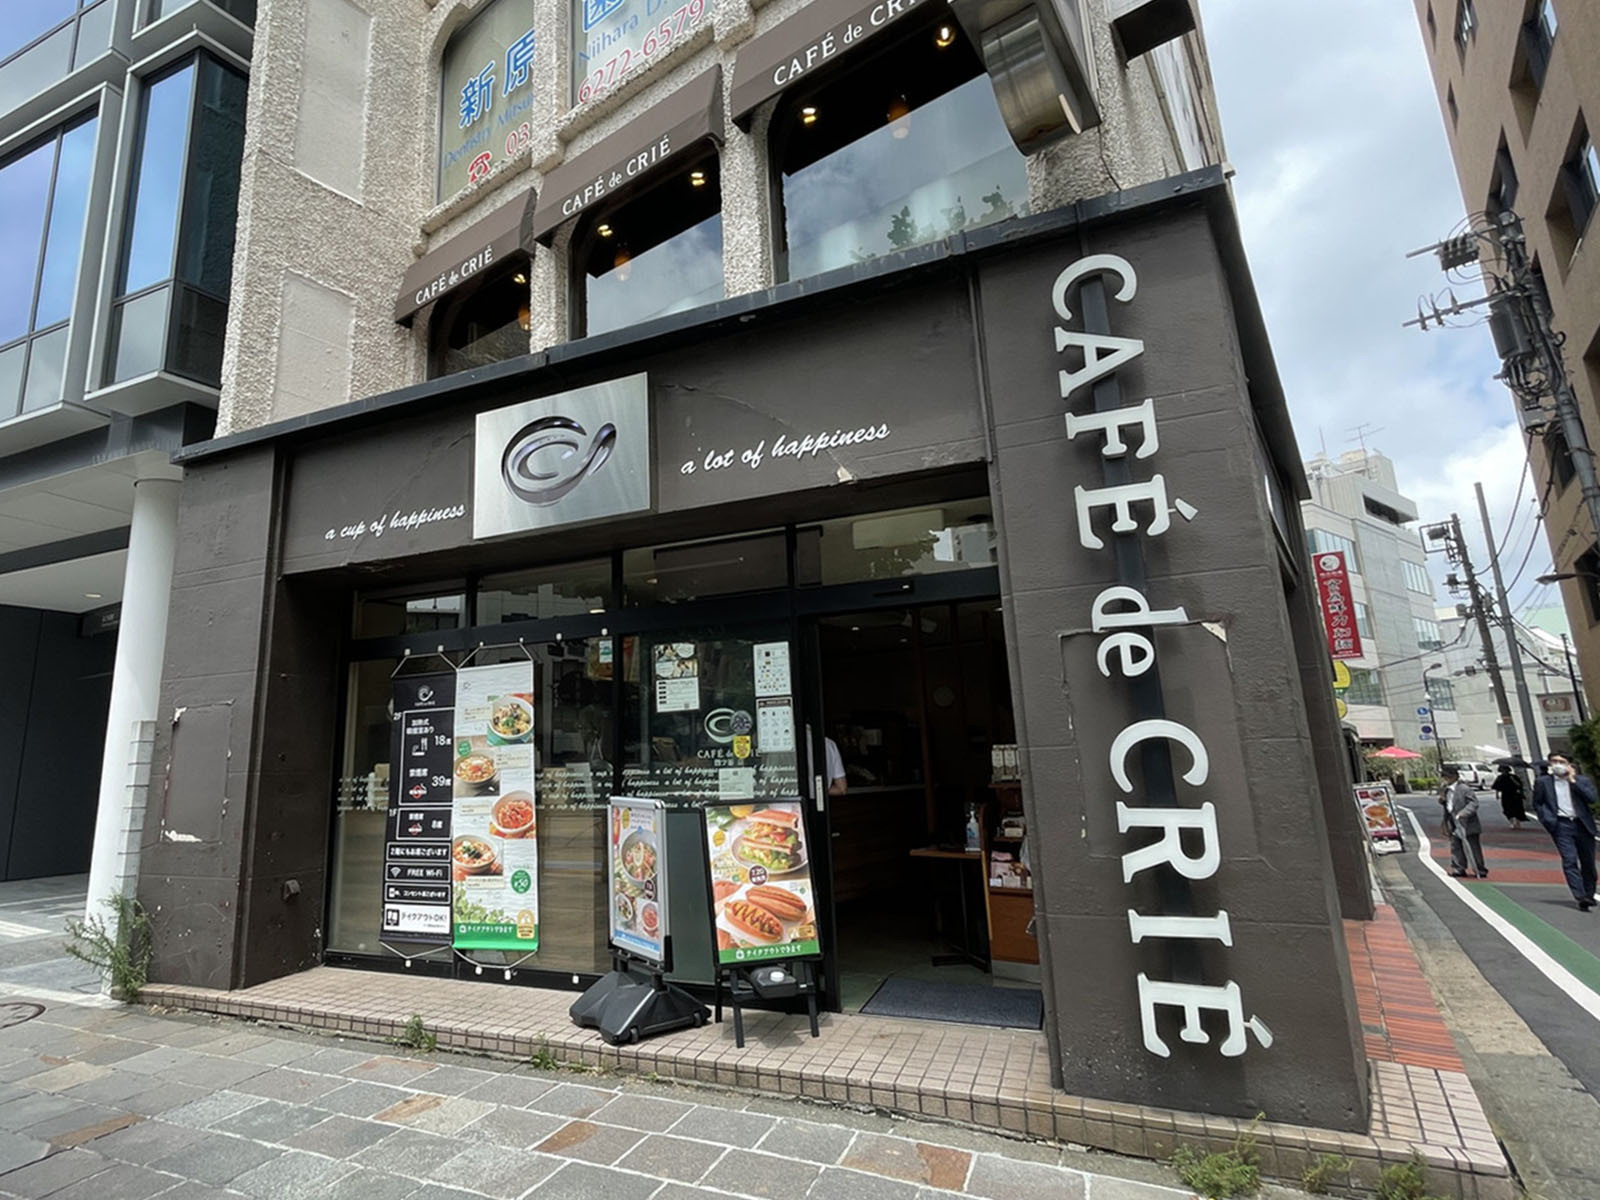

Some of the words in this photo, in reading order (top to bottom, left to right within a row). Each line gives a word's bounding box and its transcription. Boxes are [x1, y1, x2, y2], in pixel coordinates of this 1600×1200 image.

[459, 28, 535, 129] 新原
[578, 14, 639, 67] Niihara
[578, 0, 704, 104] 6272-6579
[773, 33, 837, 86] CAFÉ
[843, 24, 863, 44] de
[870, 0, 916, 26] CR
[562, 175, 605, 215] CAFÉ
[608, 172, 623, 189] de
[626, 135, 671, 177] CRIÉ
[415, 268, 446, 306] CAFÉ
[448, 270, 459, 285] de
[460, 244, 493, 279] CRIÉ
[1052, 253, 1199, 550] CAFÉ
[680, 460, 696, 476] a
[703, 447, 733, 472] lot
[740, 438, 764, 468] of
[771, 422, 890, 463] happiness
[324, 526, 337, 540] a
[340, 522, 368, 543] cup
[370, 517, 387, 538] of
[390, 503, 466, 531] happiness
[1091, 585, 1191, 679] de
[697, 749, 724, 759] CAFÉ
[1108, 718, 1274, 1060] CRIÉ
